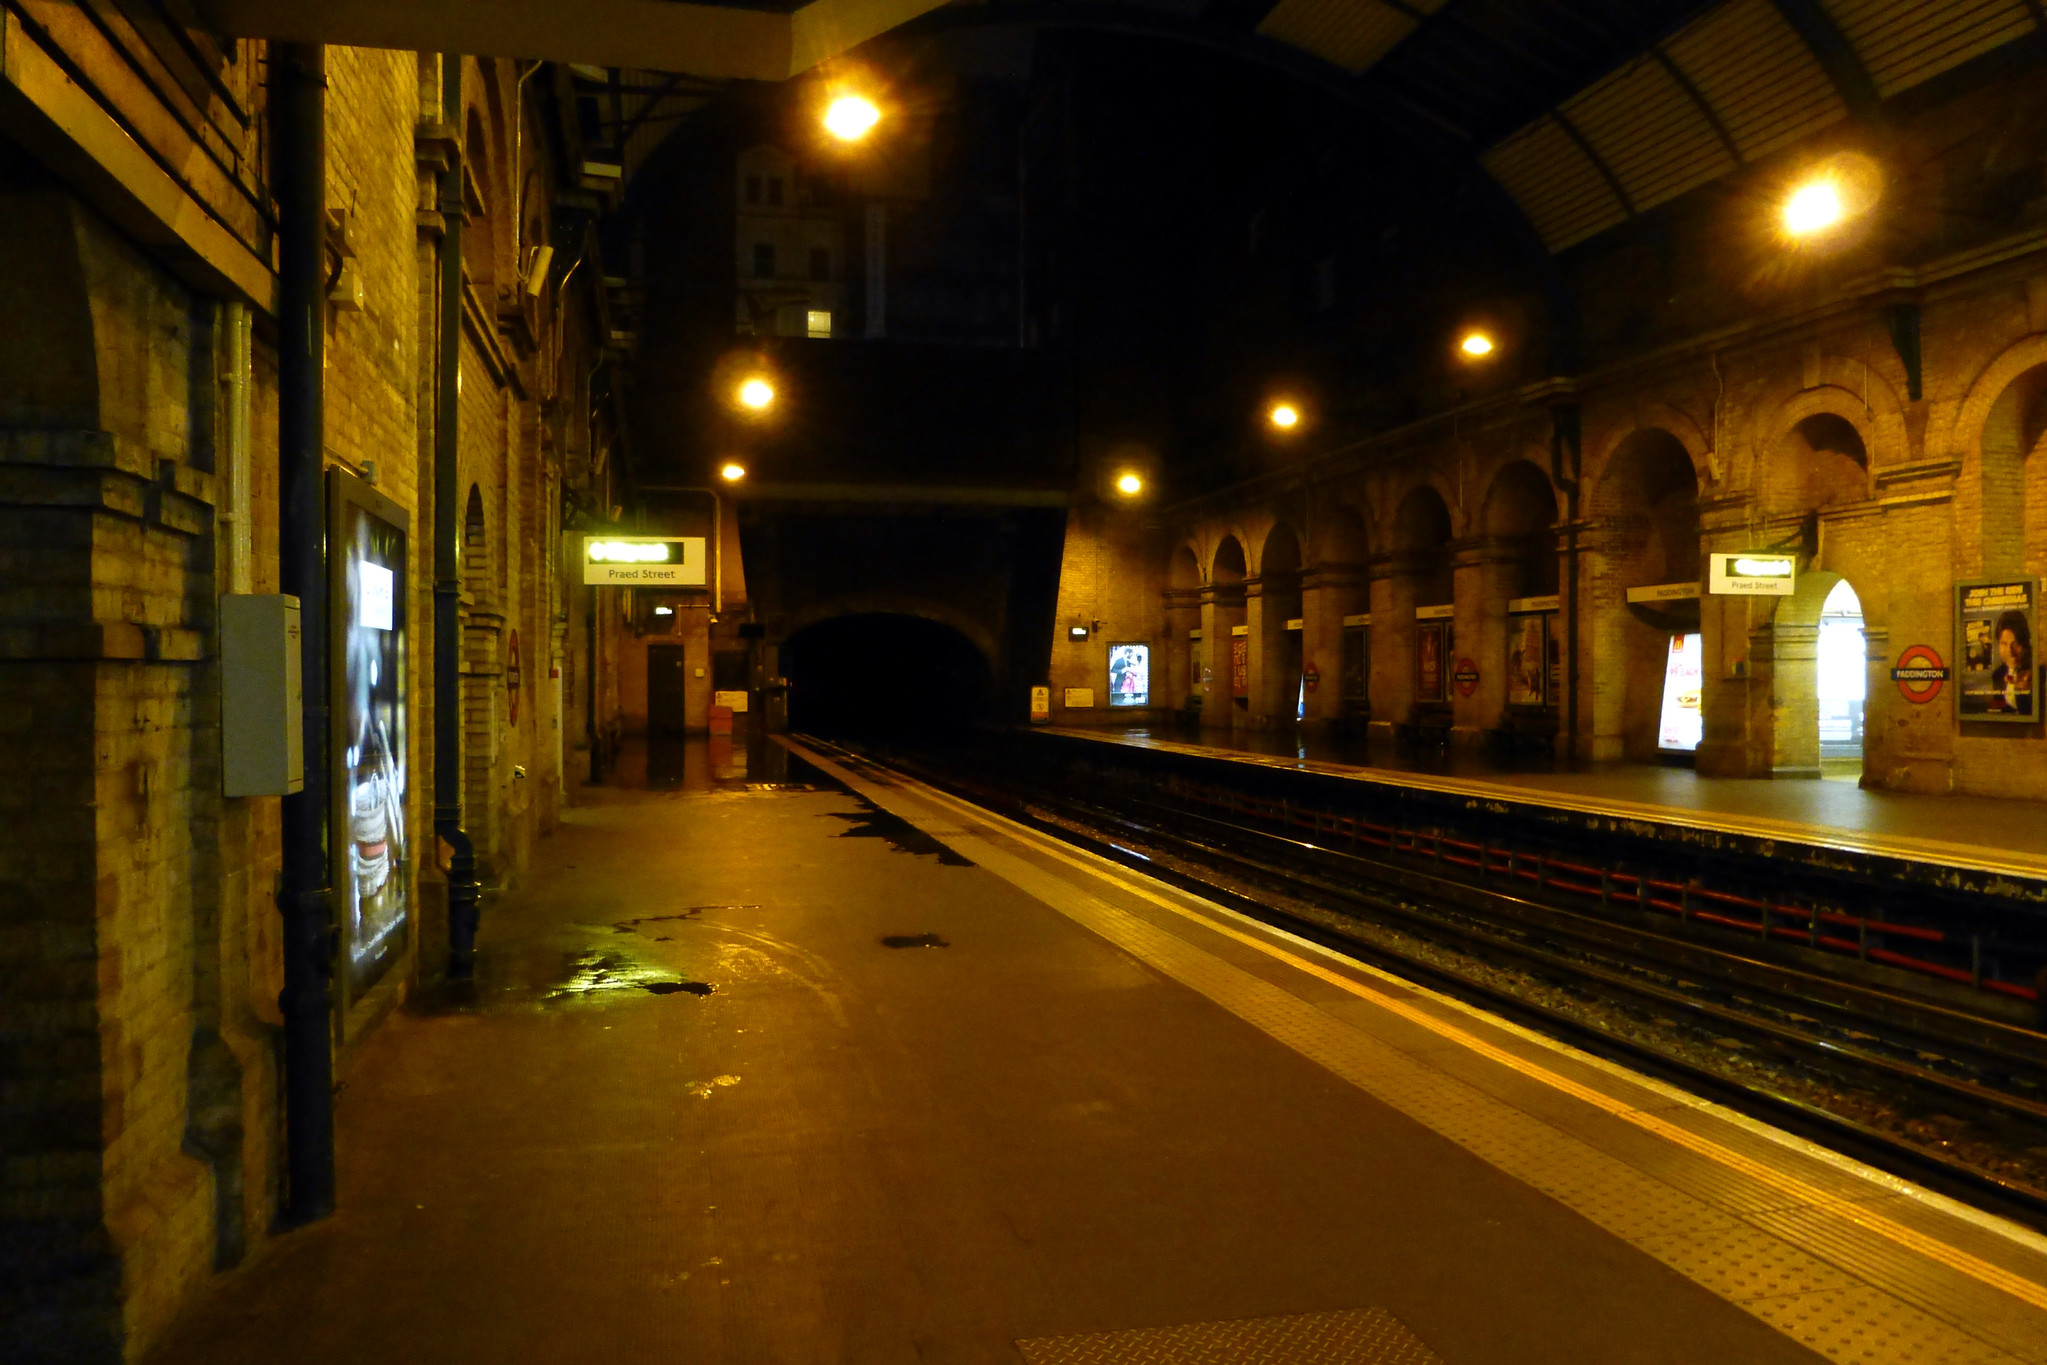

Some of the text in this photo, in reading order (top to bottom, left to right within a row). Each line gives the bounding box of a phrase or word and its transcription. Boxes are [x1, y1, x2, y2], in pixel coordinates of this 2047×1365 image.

[608, 569, 676, 579] Praed Street
[1731, 581, 1778, 590] Praed Street
[1896, 669, 1944, 679] PADDINGTON
